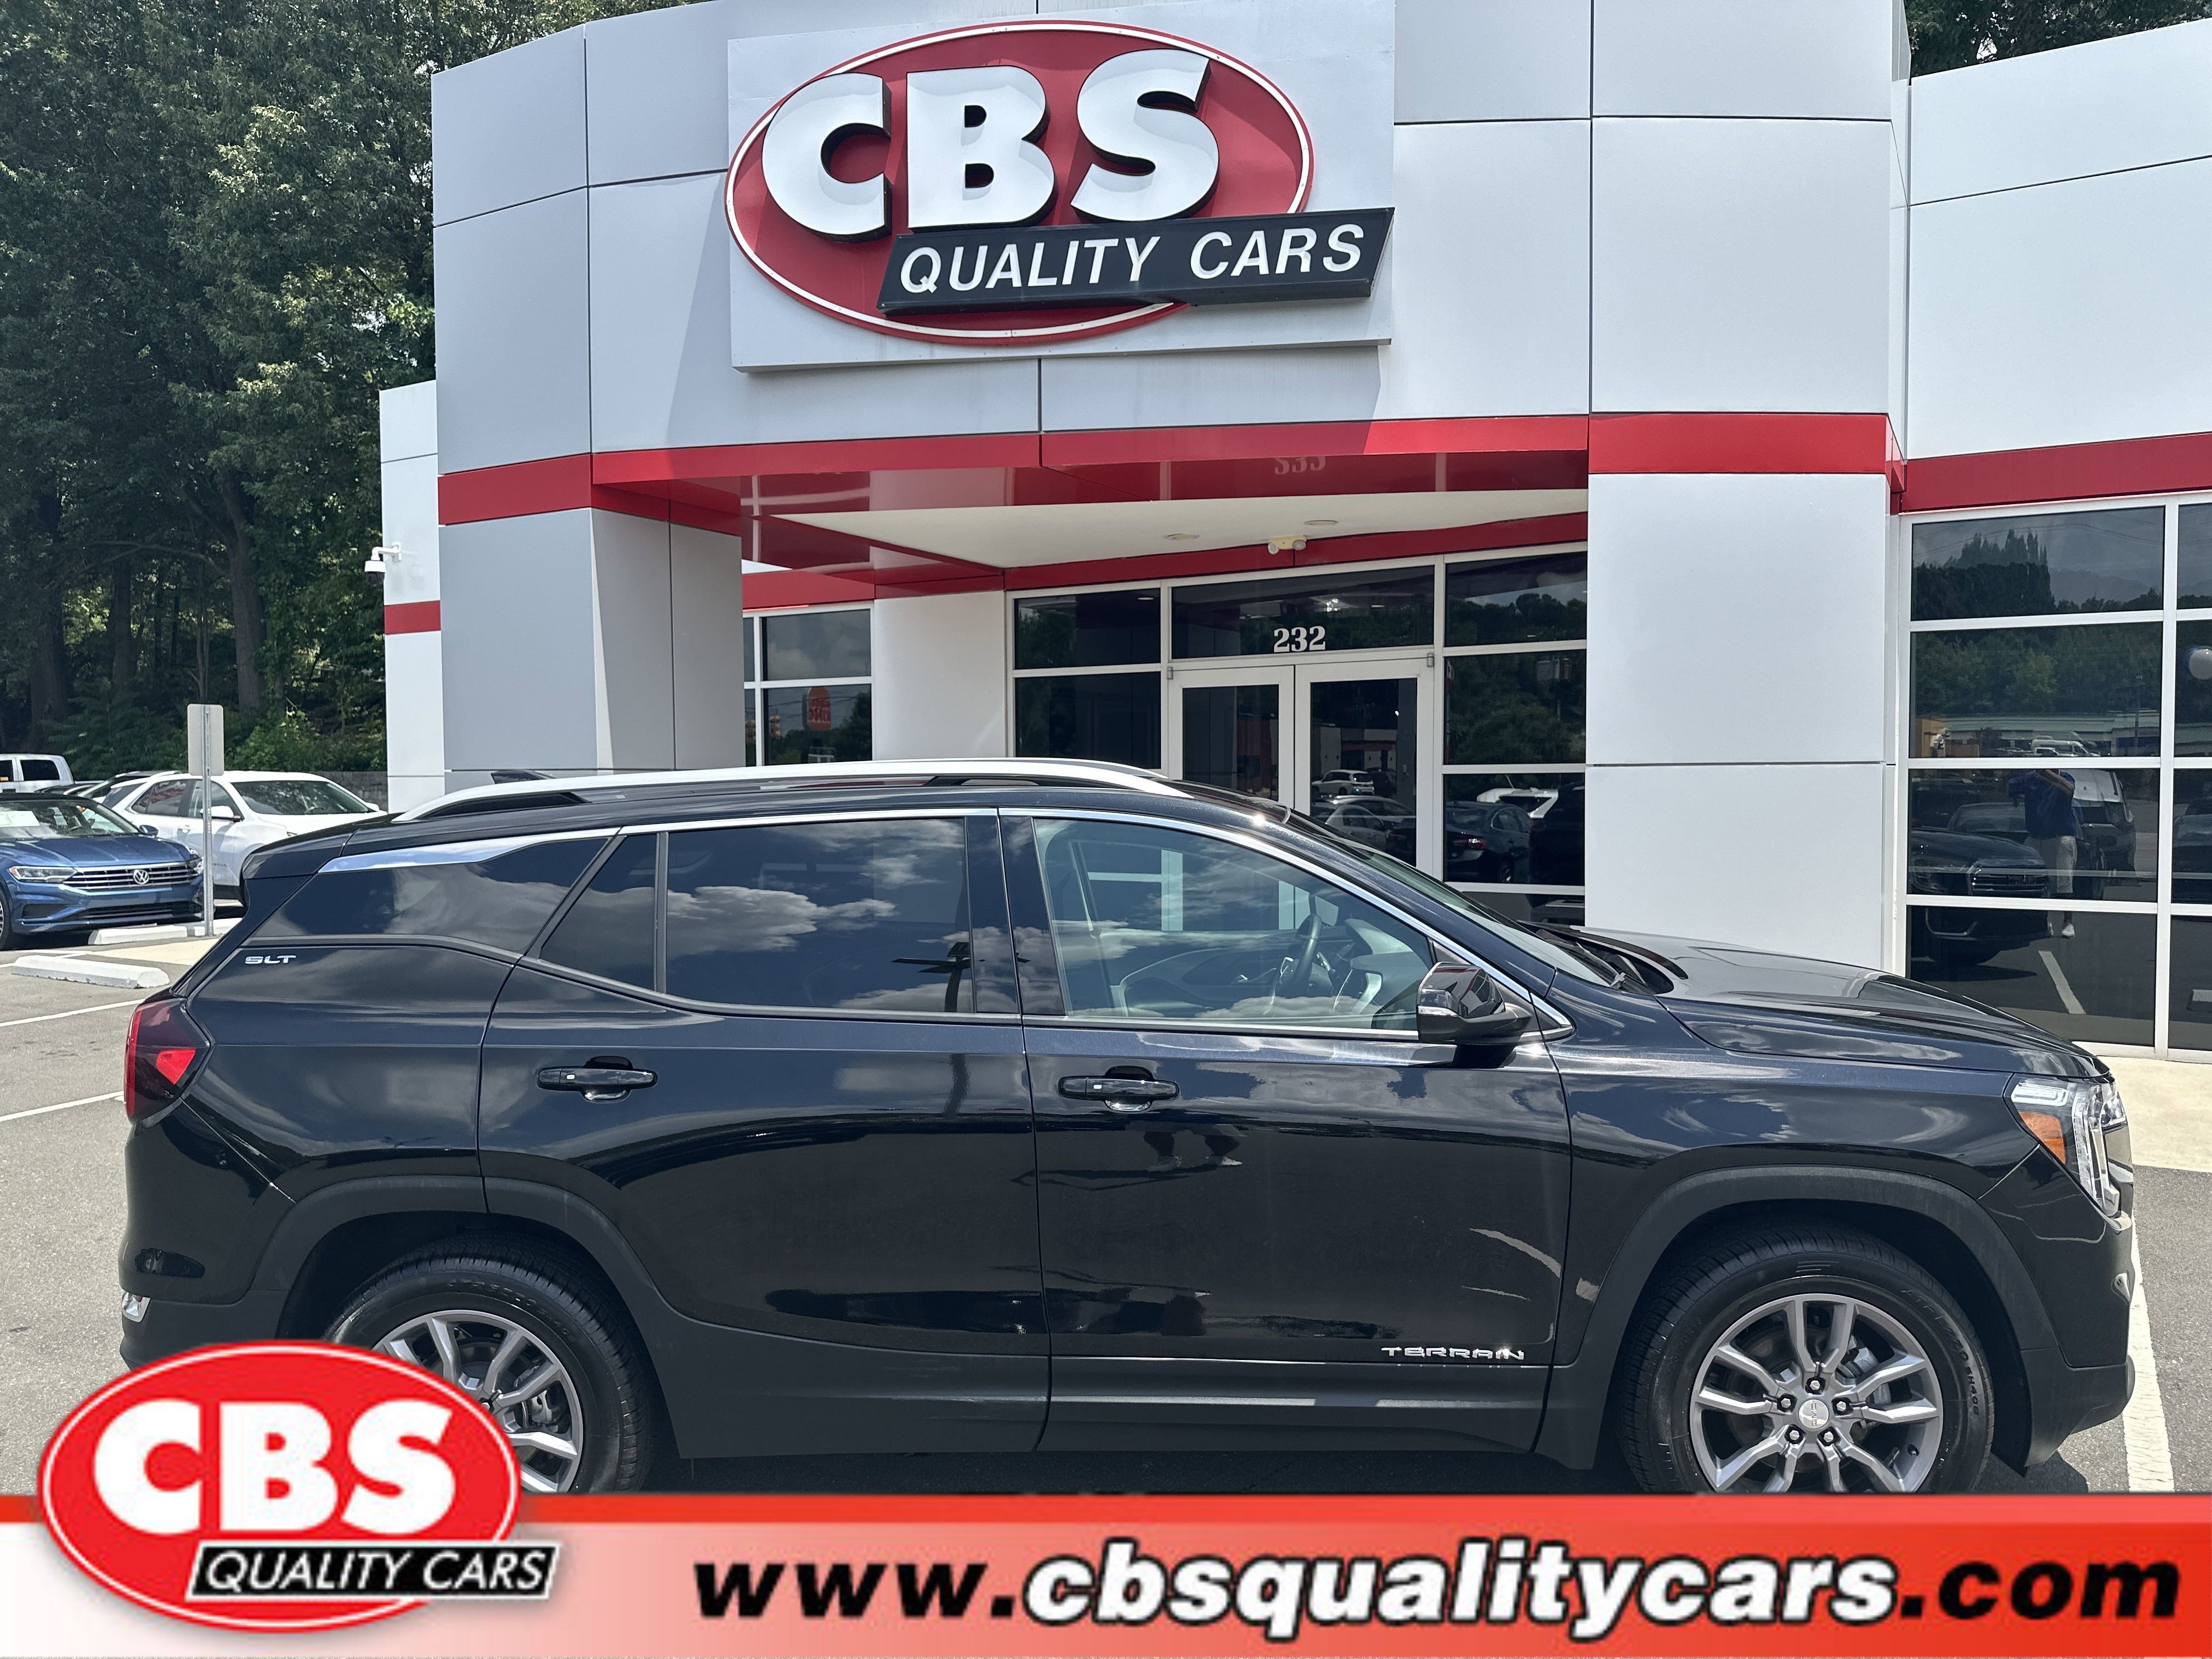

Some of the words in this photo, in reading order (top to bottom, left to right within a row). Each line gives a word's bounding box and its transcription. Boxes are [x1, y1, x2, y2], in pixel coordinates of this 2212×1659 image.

[762, 48, 1220, 241] CBS
[900, 236, 1161, 293] QUALITY
[1190, 224, 1364, 279] CARS
[1273, 625, 1325, 653] 232
[245, 955, 296, 964] SLT
[1381, 1346, 1525, 1361] TERRAIN
